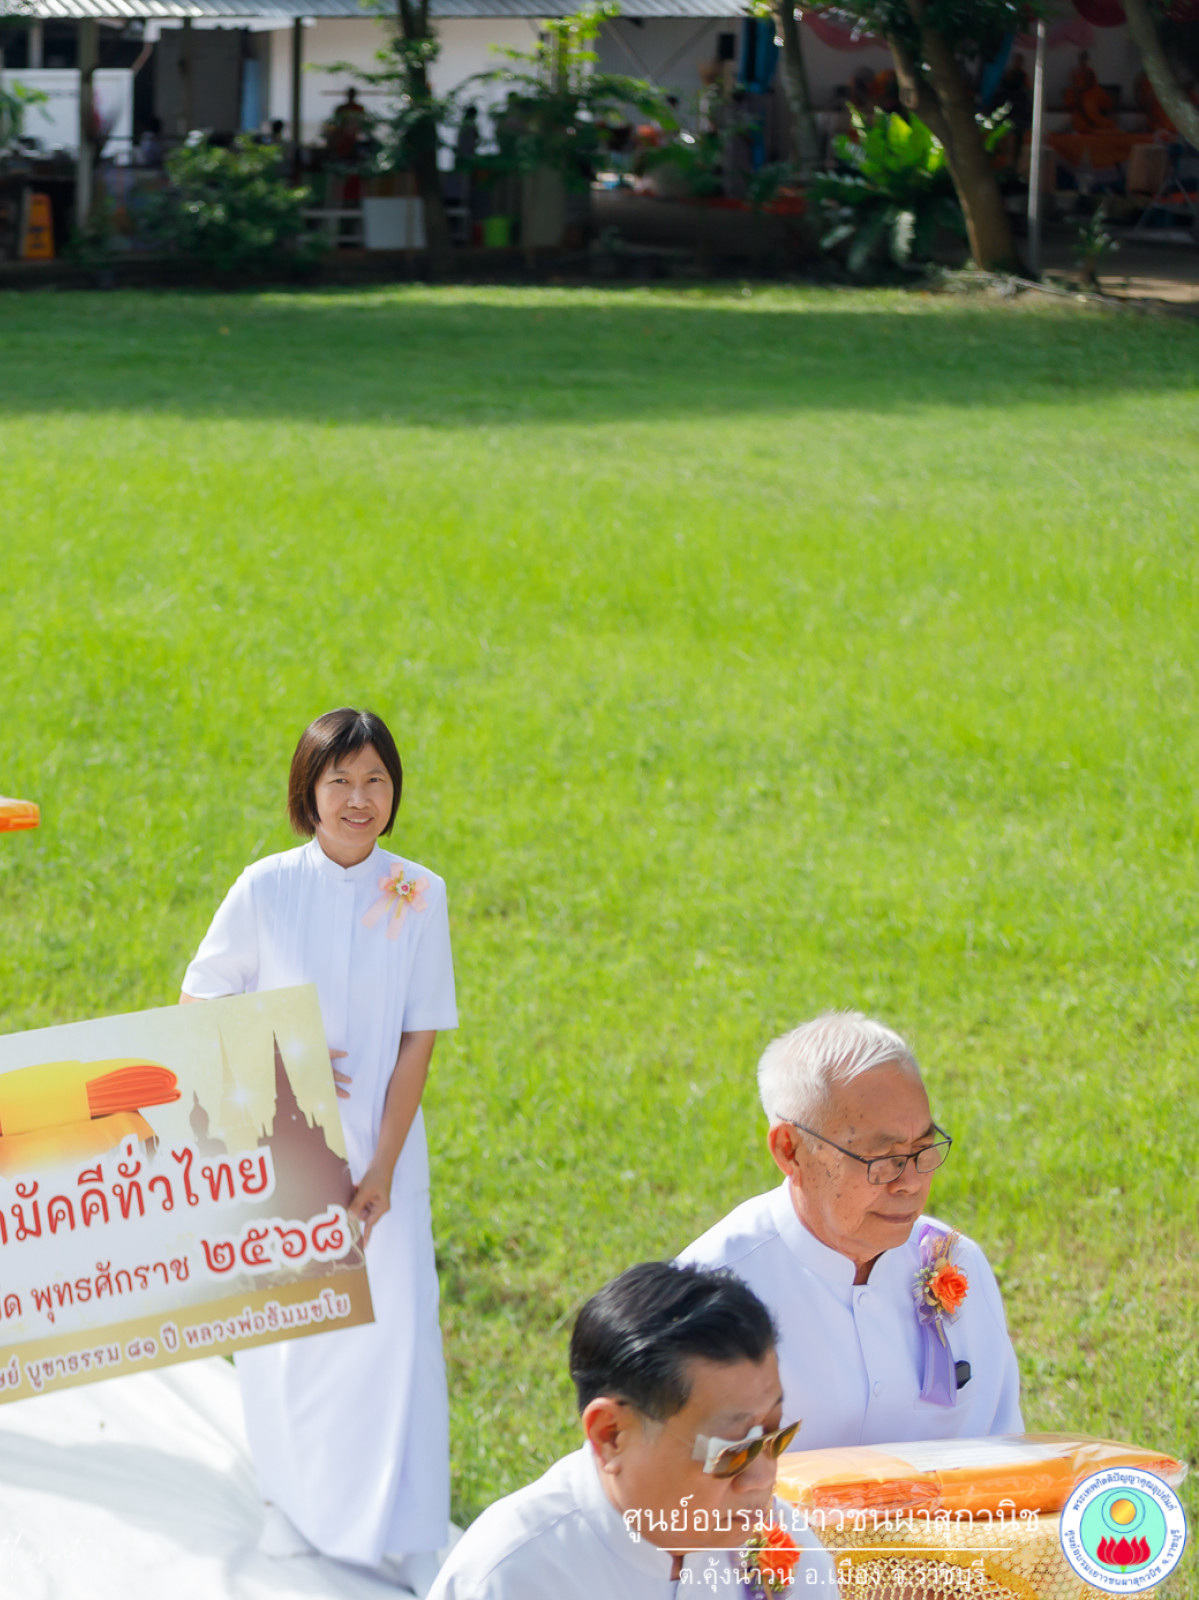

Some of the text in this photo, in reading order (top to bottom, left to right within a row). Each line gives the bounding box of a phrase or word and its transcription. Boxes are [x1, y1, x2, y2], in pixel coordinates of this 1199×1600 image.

[30, 1256, 190, 1324] พุทธศักราช
[200, 1213, 345, 1274] ๒๕๖๘
[28, 1345, 120, 1388] บูชาธรรม
[127, 1340, 156, 1358] ๘๑
[163, 1328, 177, 1350] ปี
[185, 1289, 350, 1344] หลวงพ่อธัมมชโย
